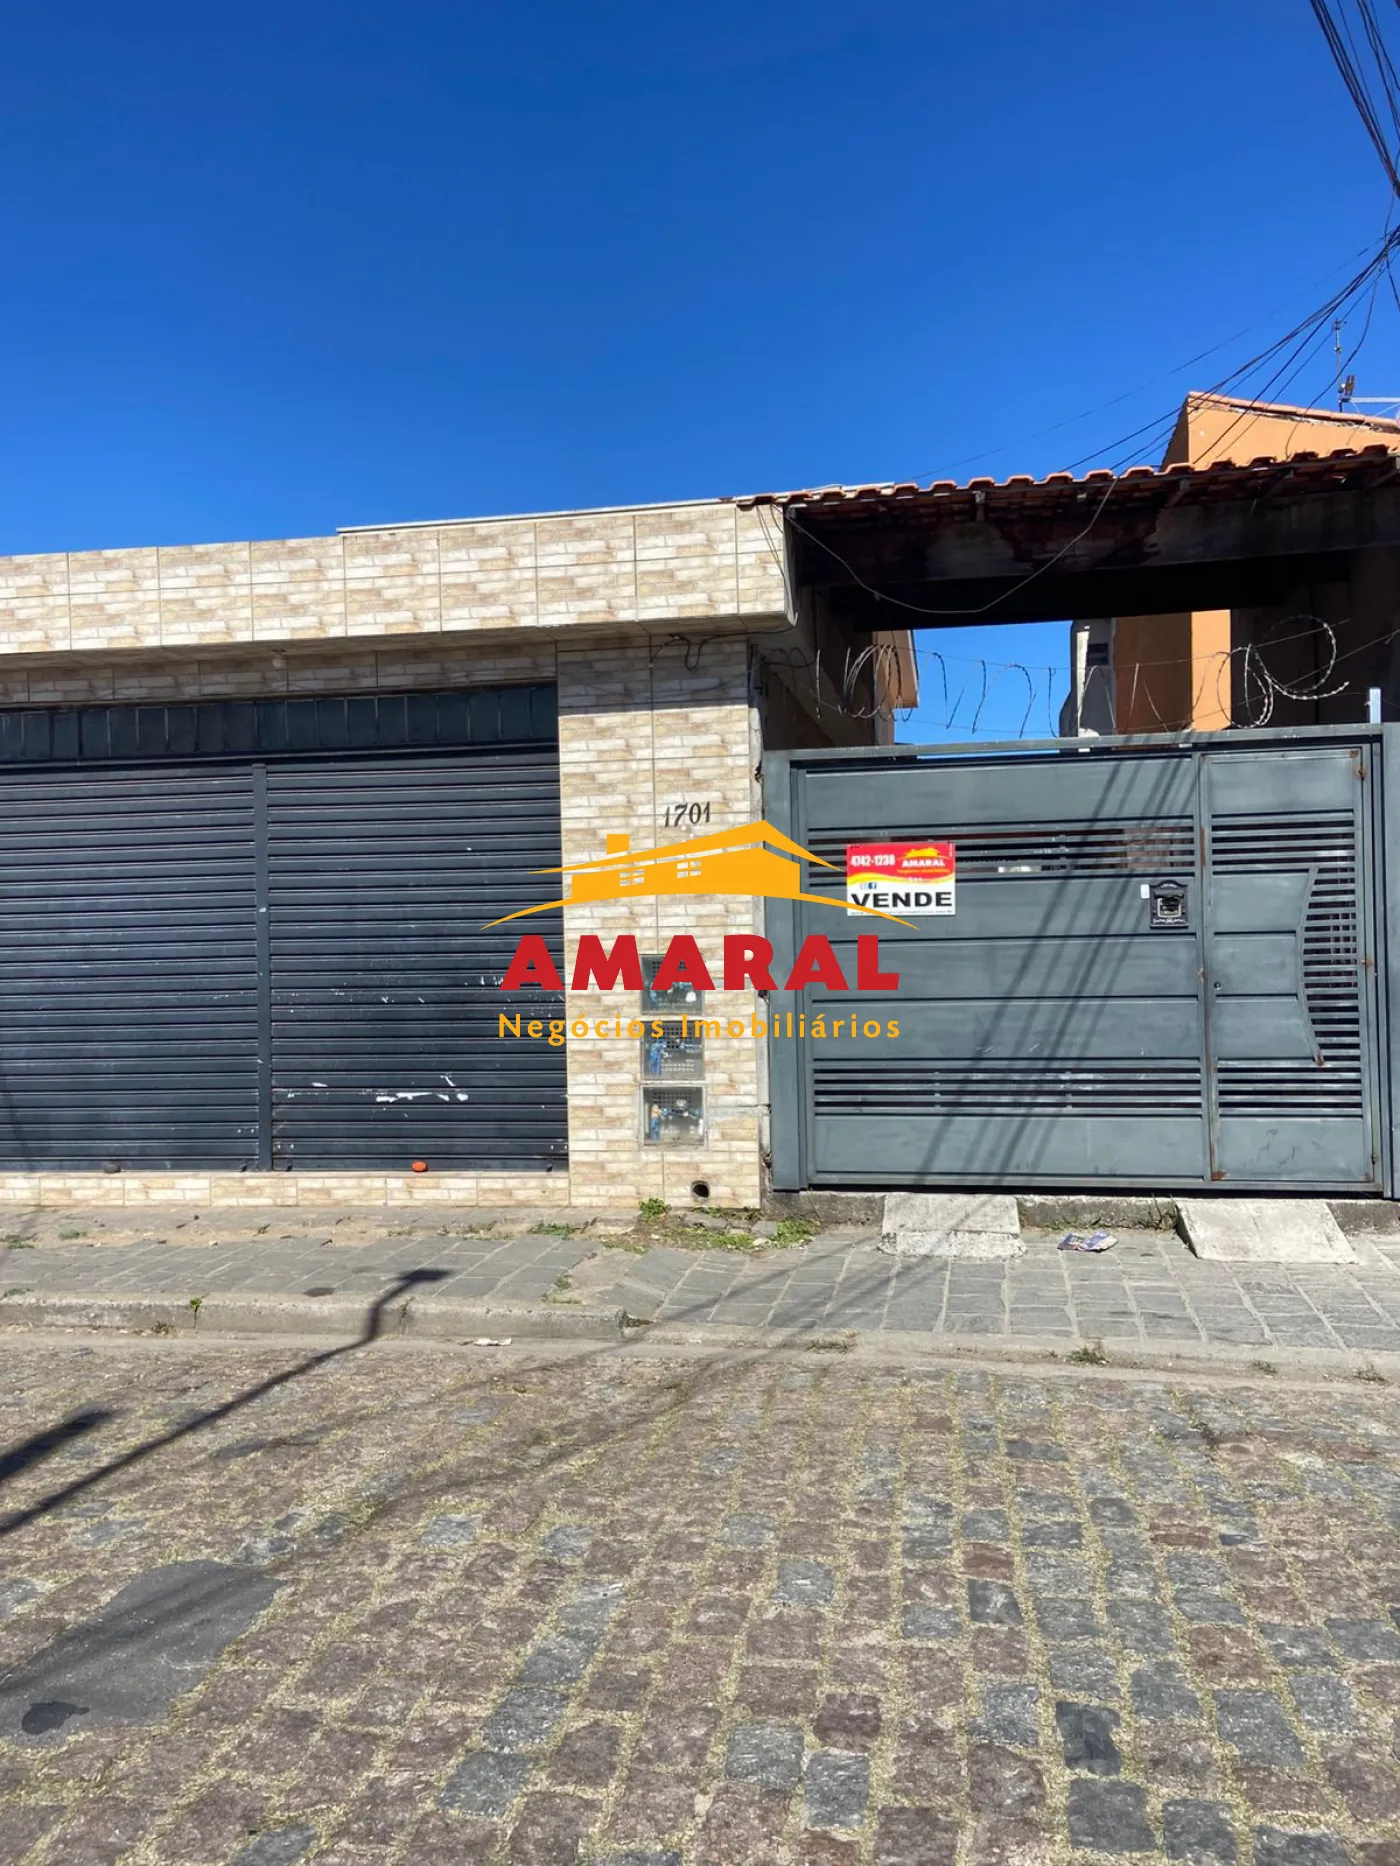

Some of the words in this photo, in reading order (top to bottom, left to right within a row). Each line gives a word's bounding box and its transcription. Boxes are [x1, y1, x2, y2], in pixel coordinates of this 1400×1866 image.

[663, 801, 710, 828] 1701
[902, 859, 945, 868] AMARAL
[851, 892, 952, 908] VENDE
